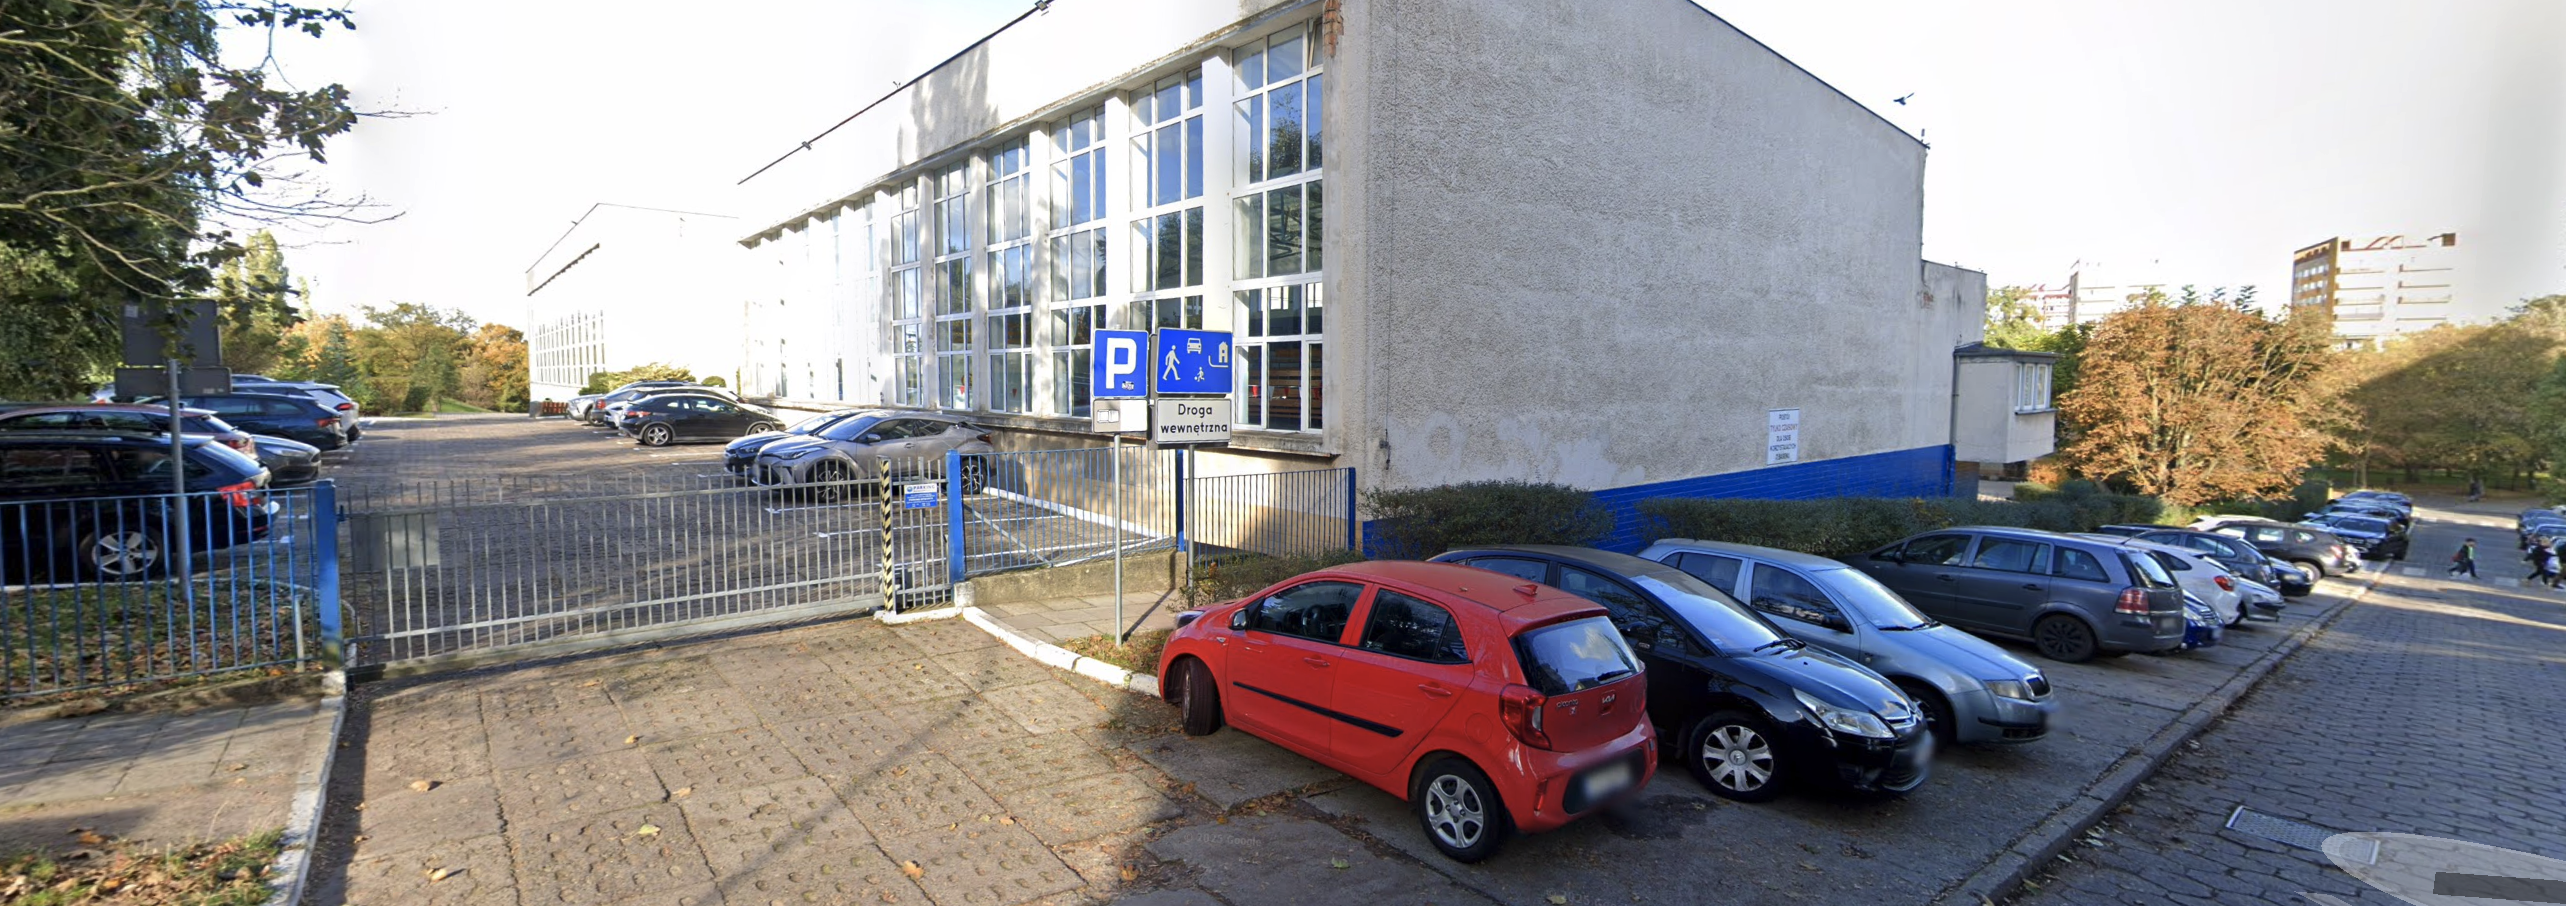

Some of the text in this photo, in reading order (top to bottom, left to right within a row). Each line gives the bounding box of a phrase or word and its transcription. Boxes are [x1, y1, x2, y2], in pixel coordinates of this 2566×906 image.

[1106, 338, 1137, 389] P
[1178, 404, 1213, 418] Droga
[1161, 423, 1228, 436] wewnętrzna
